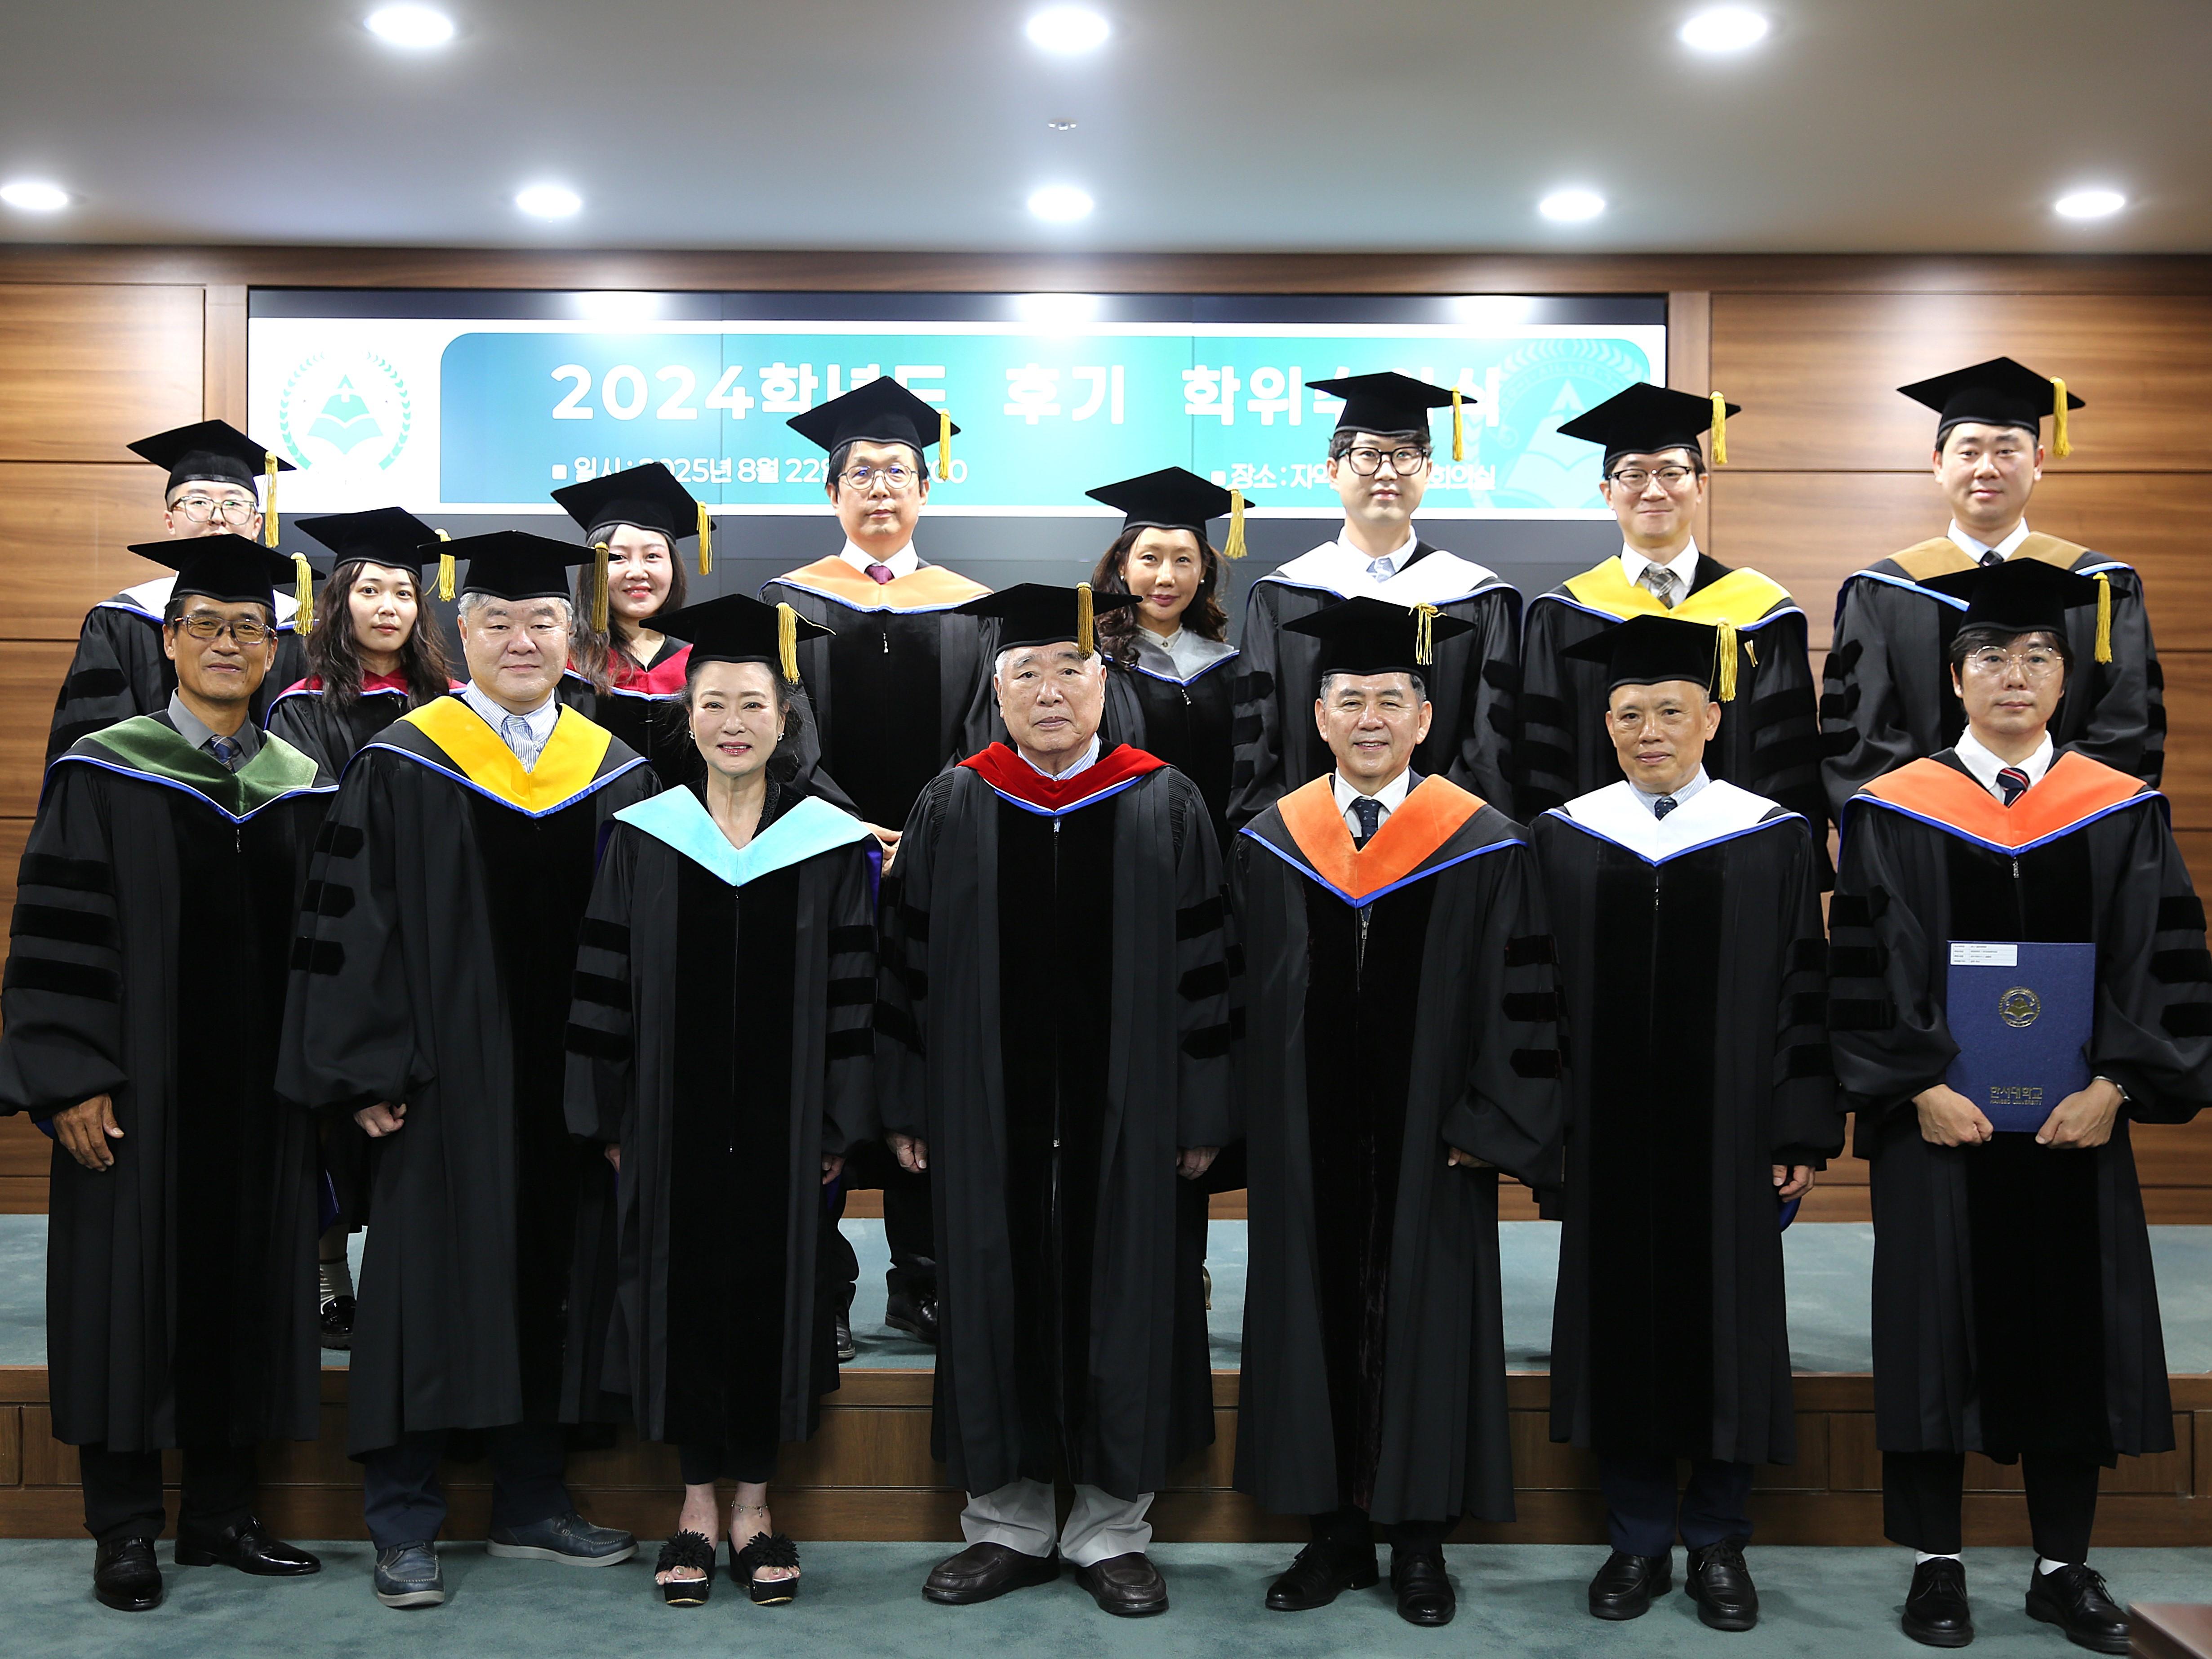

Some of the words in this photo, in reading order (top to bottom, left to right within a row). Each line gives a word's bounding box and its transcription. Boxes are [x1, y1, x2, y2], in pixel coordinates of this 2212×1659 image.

[1003, 363, 1124, 425] 후기
[737, 456, 780, 484] 8월
[1990, 1086, 2043, 1099] 한서대학교
